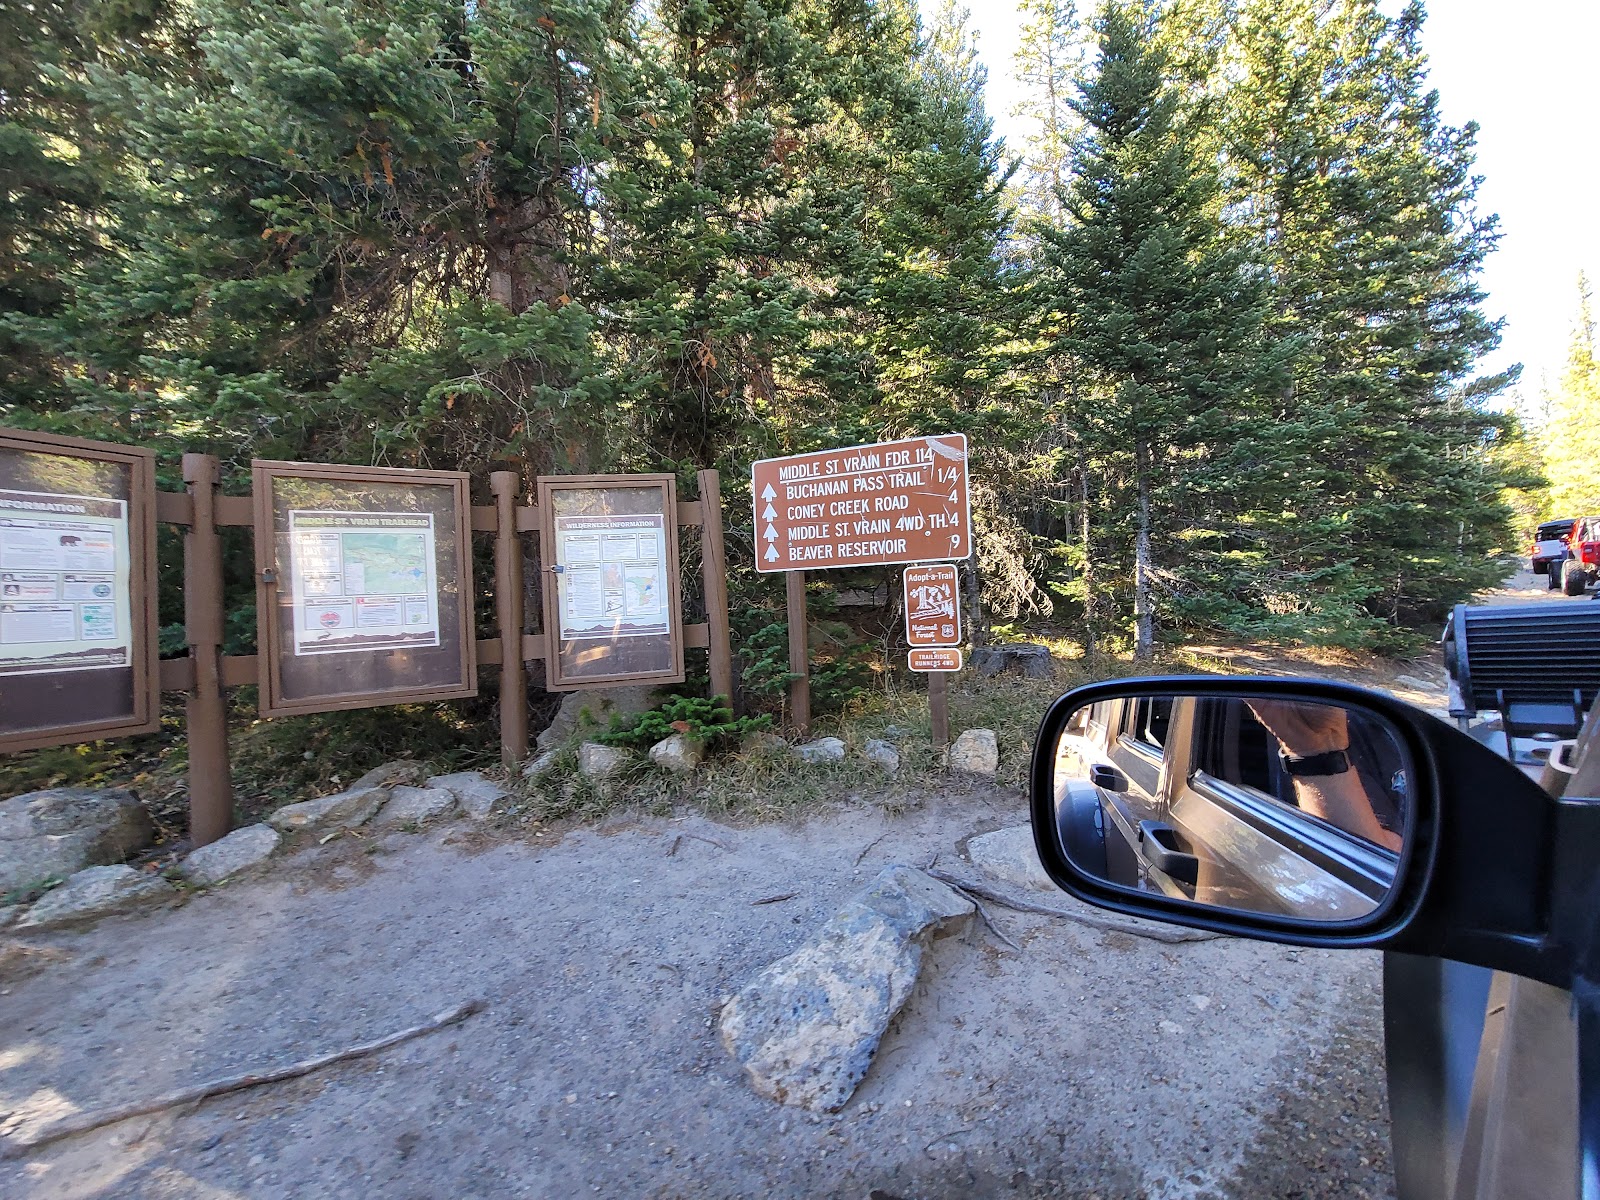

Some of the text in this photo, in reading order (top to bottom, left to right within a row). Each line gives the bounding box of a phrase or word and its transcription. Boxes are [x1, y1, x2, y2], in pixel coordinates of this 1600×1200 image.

[779, 447, 933, 481] MIDDLE ST VRAIN FDR 114
[786, 466, 957, 500] BUCHANAN PASS TRAIL 1/4
[787, 489, 958, 520] CONEY CREEK ROAD 4
[350, 518, 380, 526] VRAIN
[610, 520, 654, 528] INFORMATION
[788, 523, 830, 541] MIDDLE
[835, 522, 851, 537] ST.
[853, 518, 891, 535] VRAIN
[895, 515, 923, 532] 4WD
[949, 512, 959, 526] 4
[789, 534, 961, 561] BEAVER RESERVOIR 9
[908, 572, 953, 582] Adopt-a-Trail
